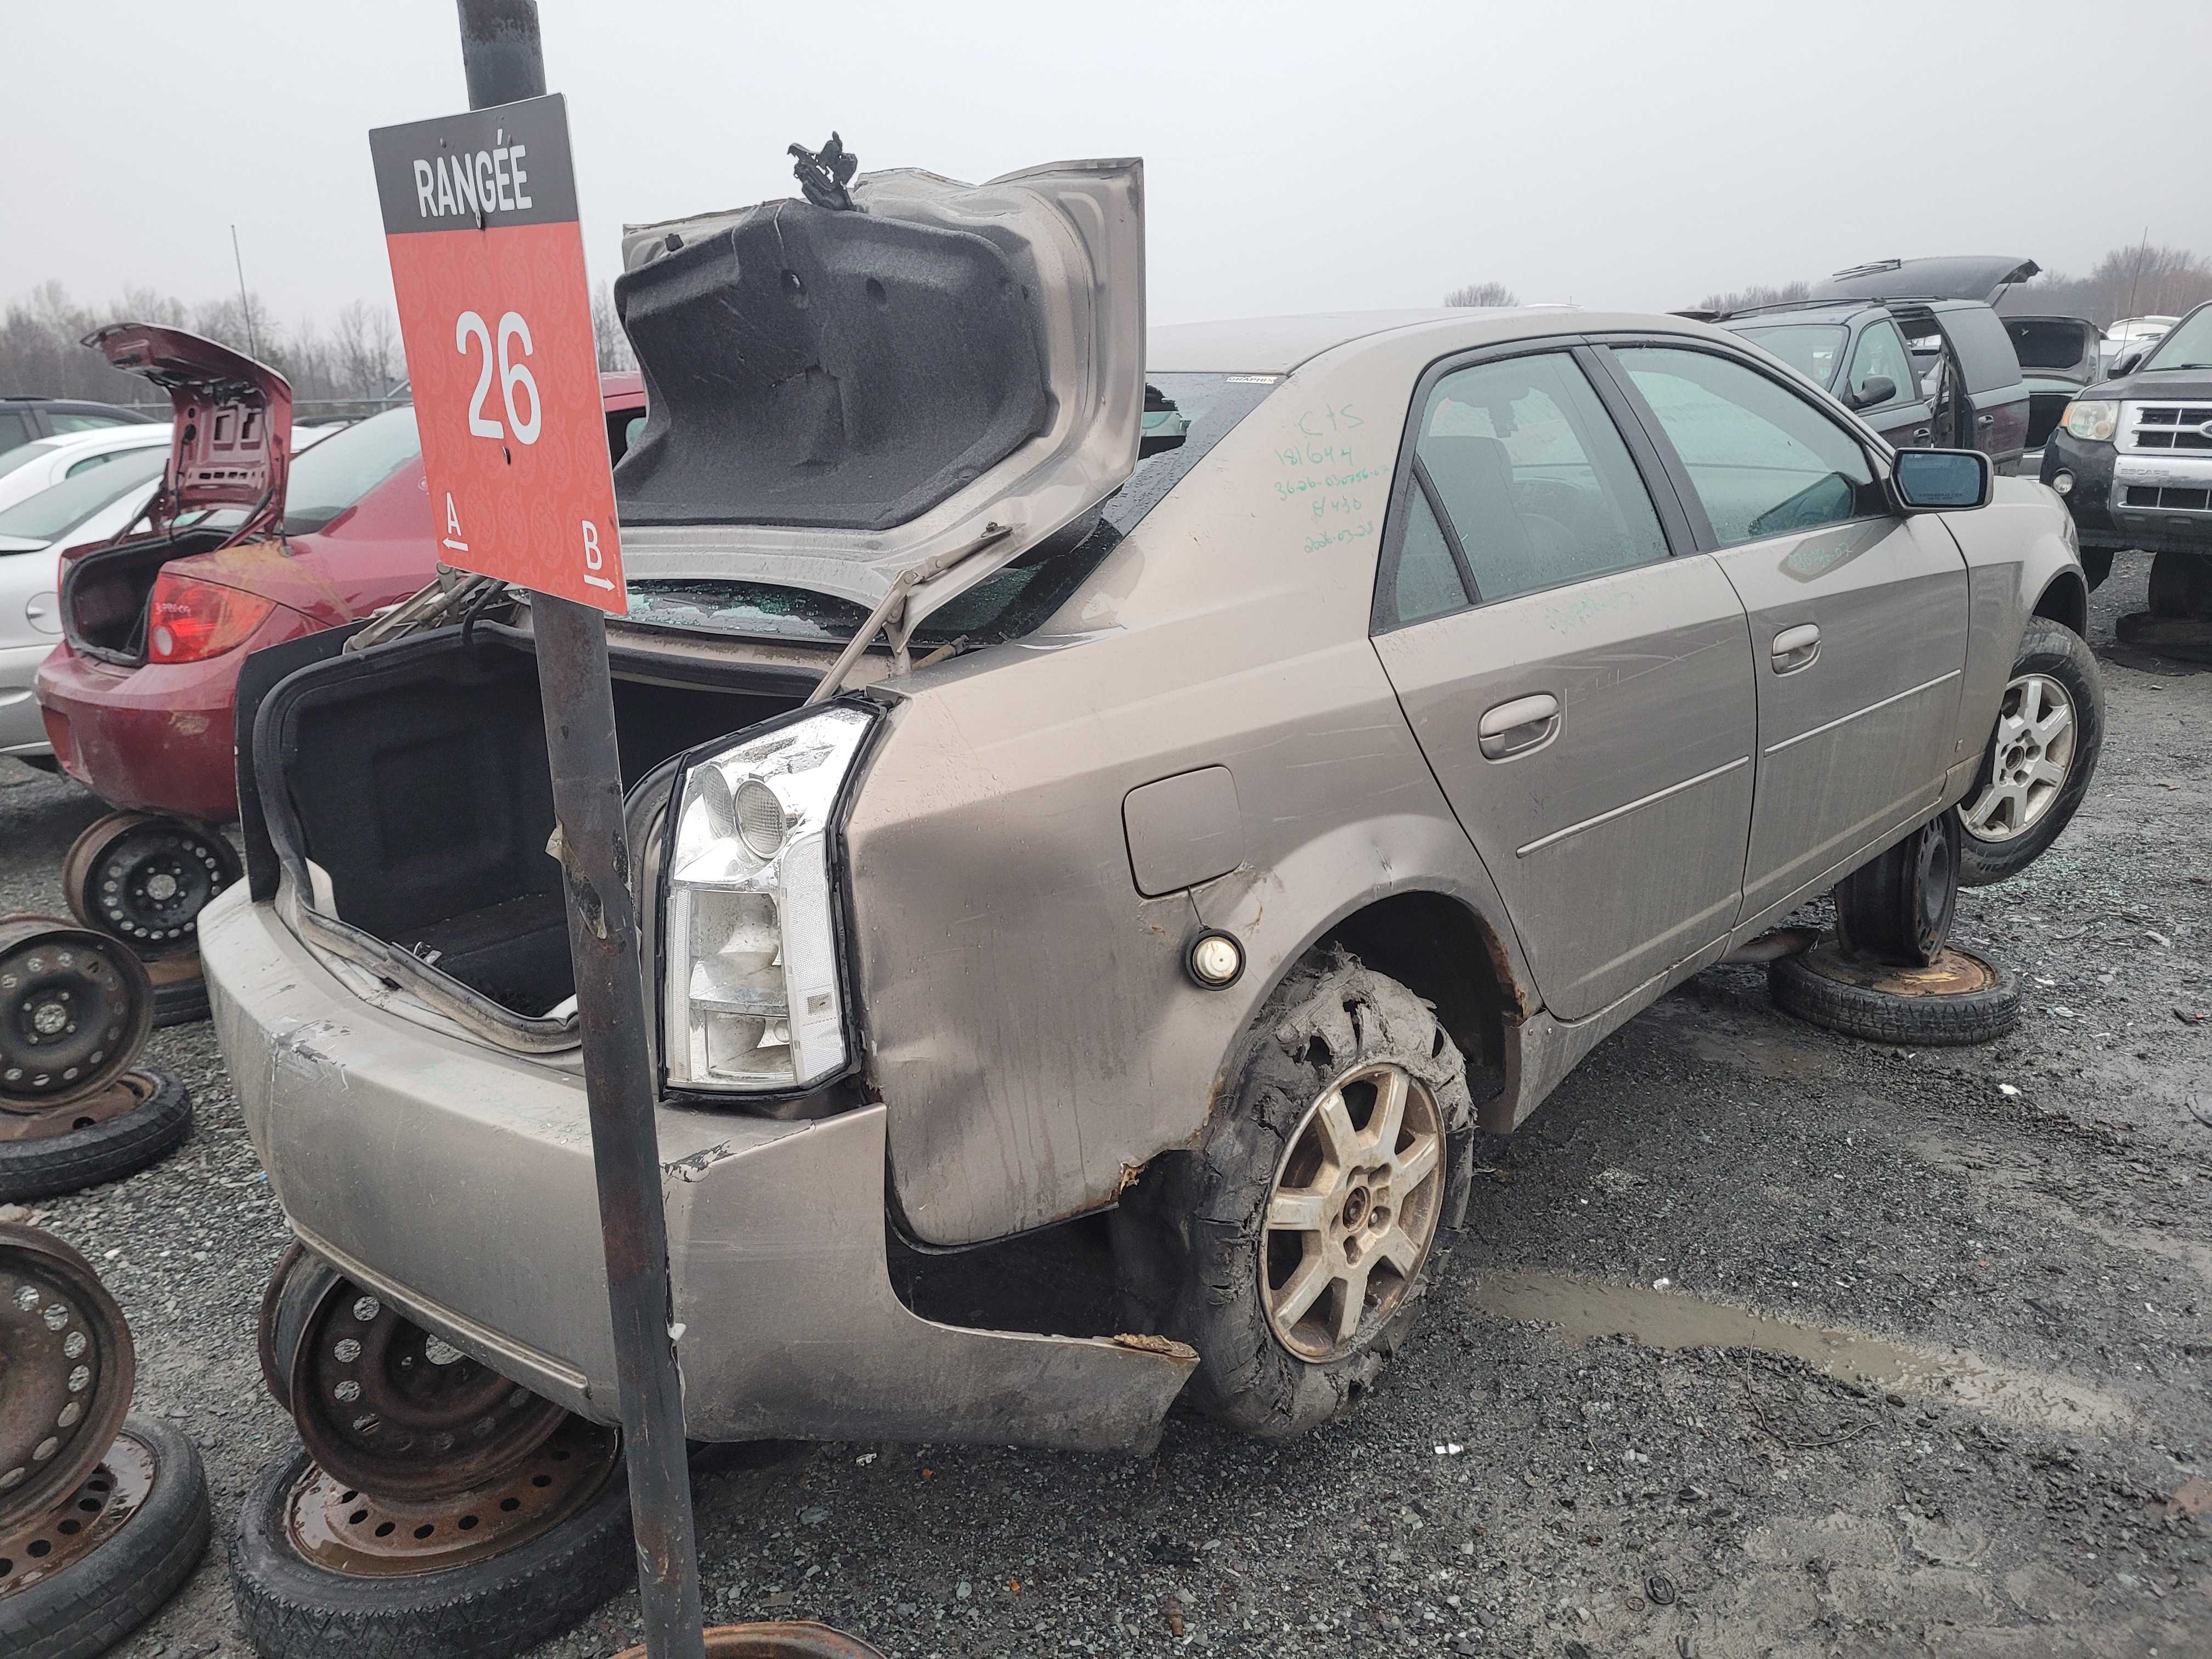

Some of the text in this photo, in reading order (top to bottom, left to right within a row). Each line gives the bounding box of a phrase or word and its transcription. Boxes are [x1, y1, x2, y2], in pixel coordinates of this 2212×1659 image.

[413, 128, 532, 218] RANGÉE
[456, 311, 541, 445] 26
[447, 492, 461, 536] A
[582, 520, 603, 570] B
